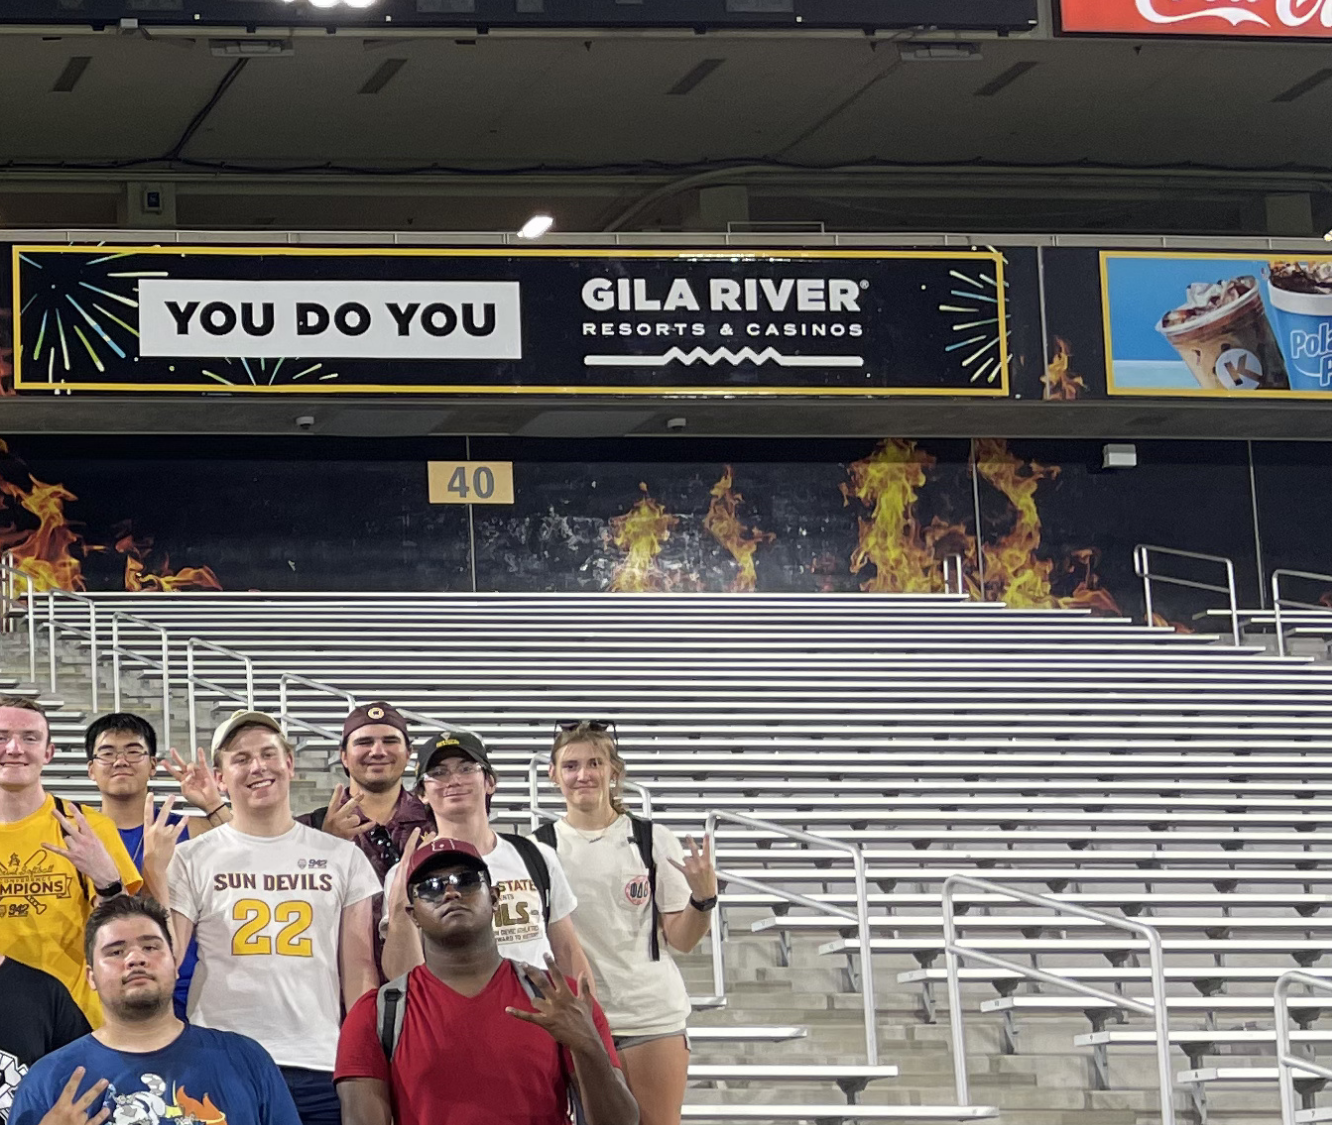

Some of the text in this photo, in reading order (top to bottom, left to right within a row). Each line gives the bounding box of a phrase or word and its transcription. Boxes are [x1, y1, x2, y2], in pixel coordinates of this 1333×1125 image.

[582, 278, 700, 311] GILA
[165, 301, 496, 337] YOU DO YOU
[582, 323, 864, 336] RESORTS & CASINOS
[447, 466, 495, 499] 40
[213, 873, 333, 892] SUN DEVILS
[231, 898, 314, 957] 22
